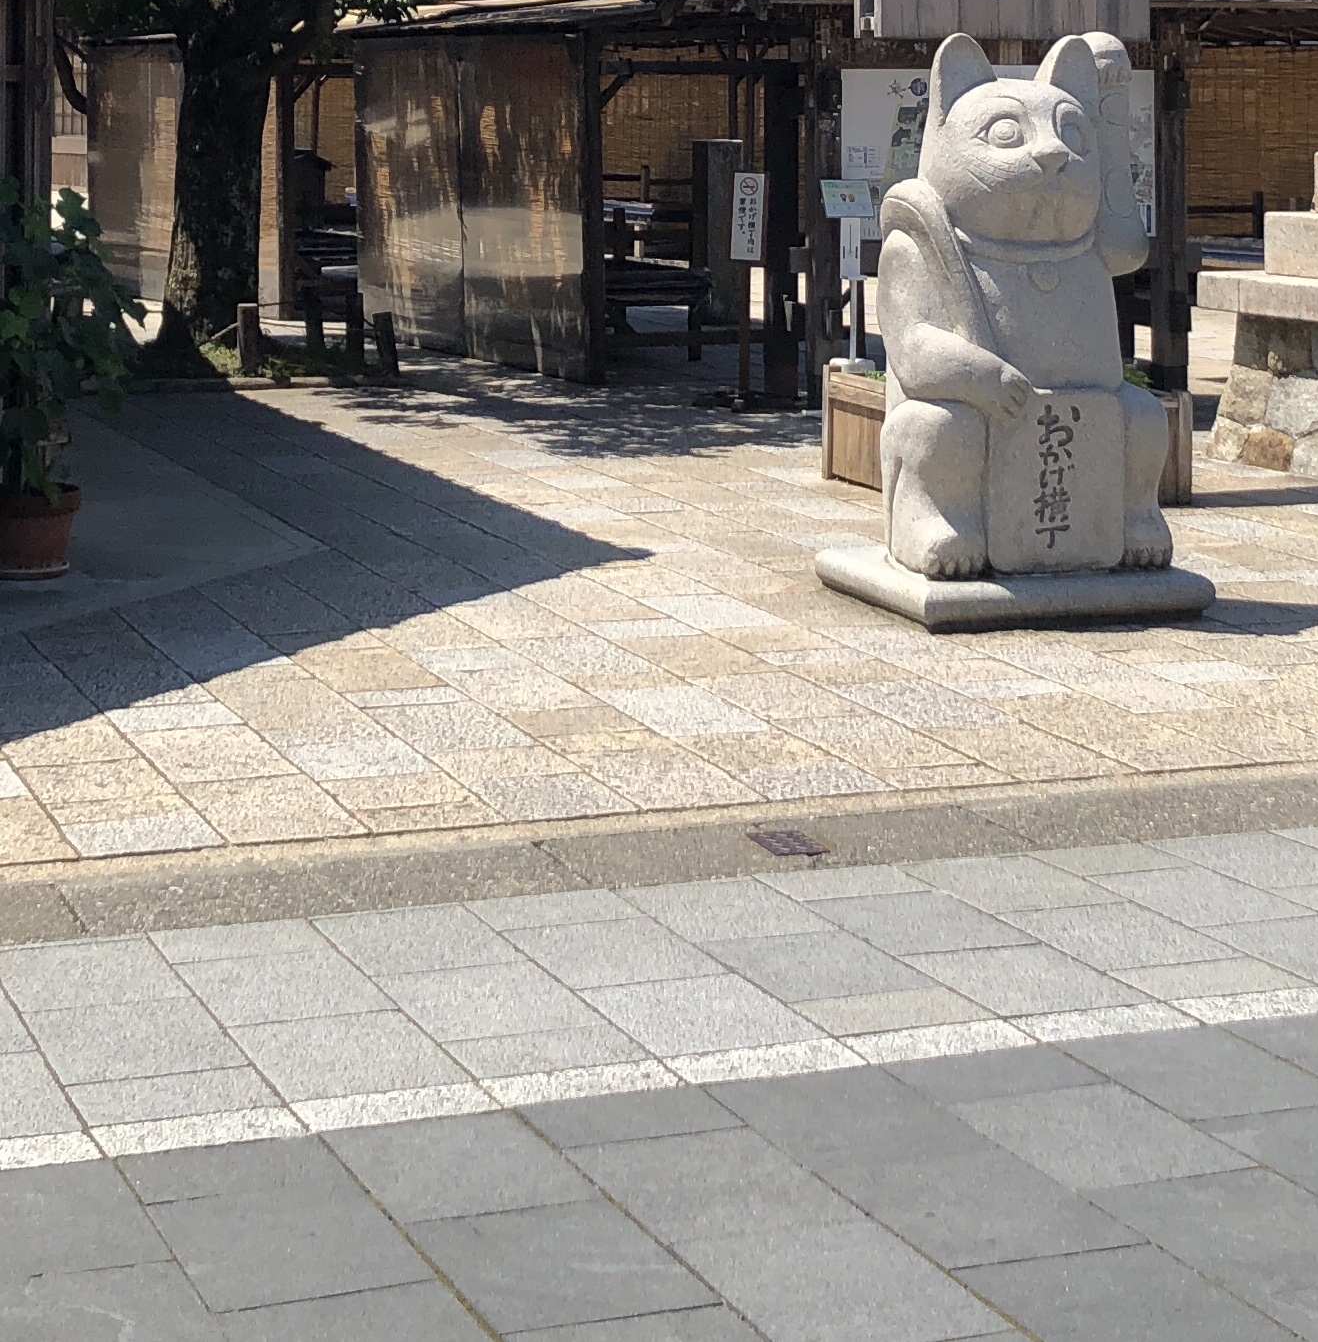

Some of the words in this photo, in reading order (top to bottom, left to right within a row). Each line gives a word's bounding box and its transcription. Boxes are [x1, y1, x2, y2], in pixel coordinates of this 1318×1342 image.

[1033, 404, 1081, 549] おかげ横丁
